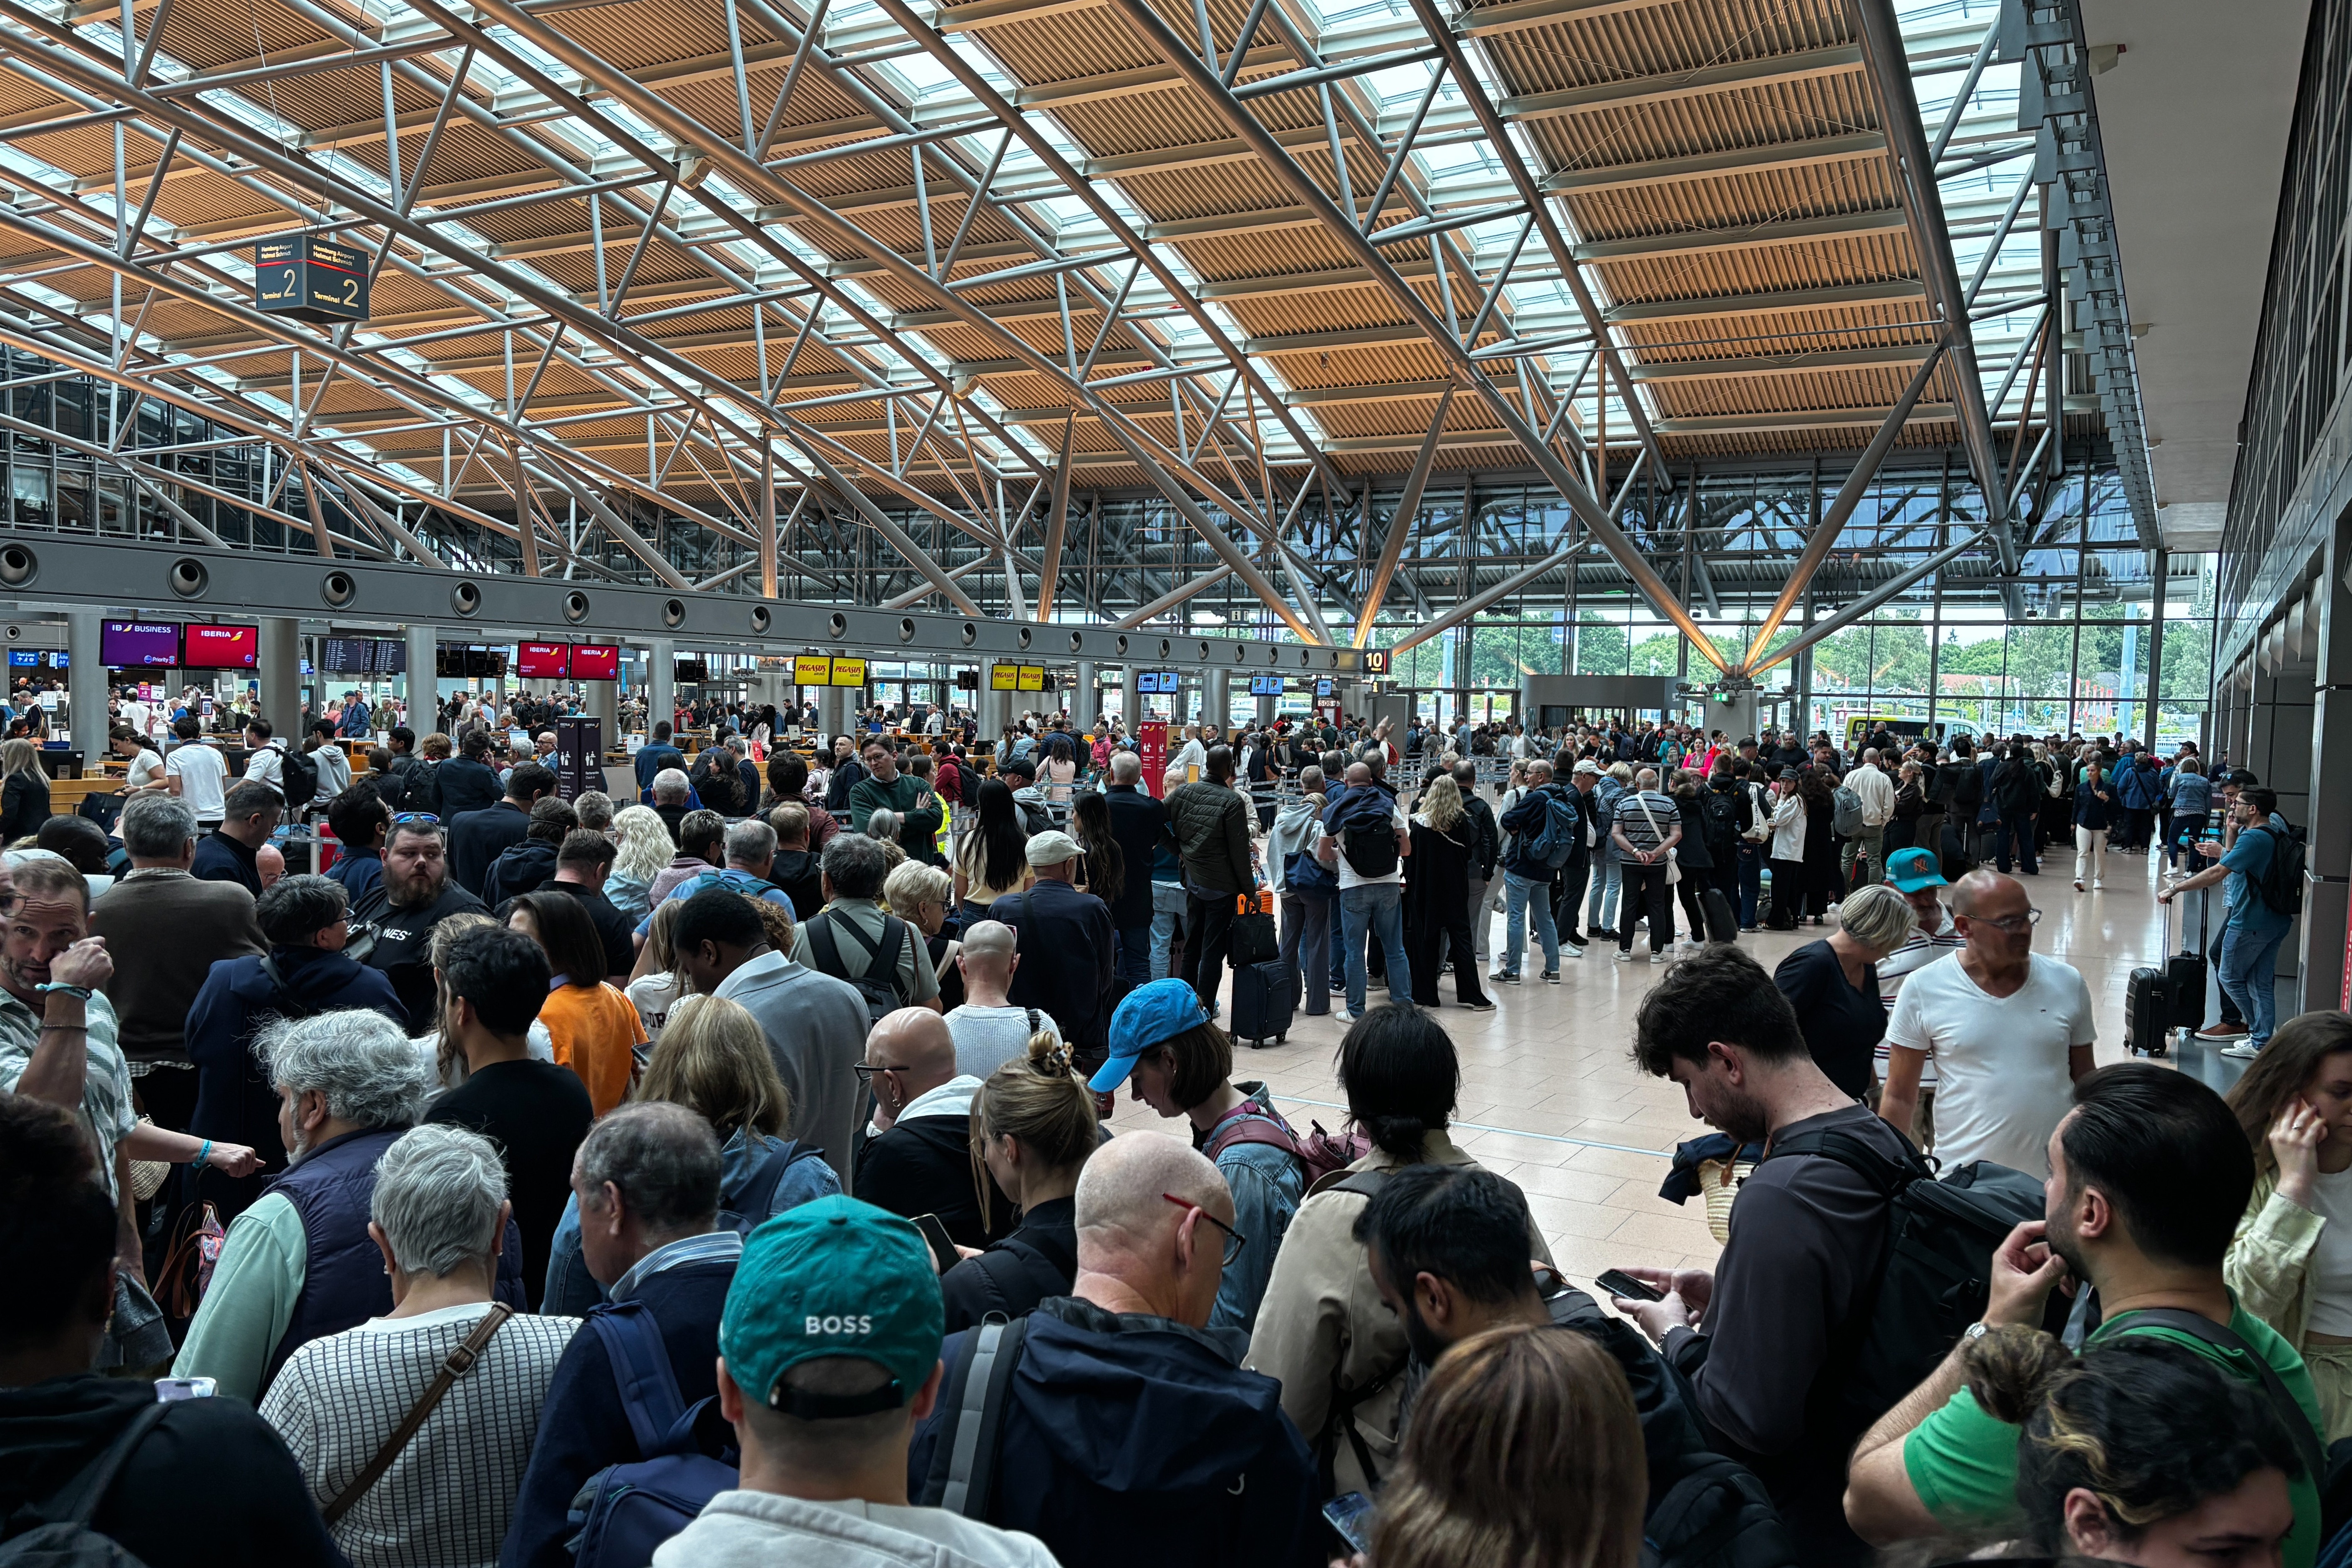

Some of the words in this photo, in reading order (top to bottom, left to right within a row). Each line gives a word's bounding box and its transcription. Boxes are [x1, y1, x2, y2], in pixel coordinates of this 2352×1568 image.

[313, 244, 337, 256] Hamburg
[337, 251, 355, 260] Airport
[313, 251, 332, 261] Helmut
[332, 256, 352, 266] Schmidt
[284, 269, 296, 297] 2
[313, 291, 340, 304] Terminal
[343, 279, 359, 308] 2
[1366, 652, 1383, 667] 10
[806, 1315, 873, 1334] BOSS
